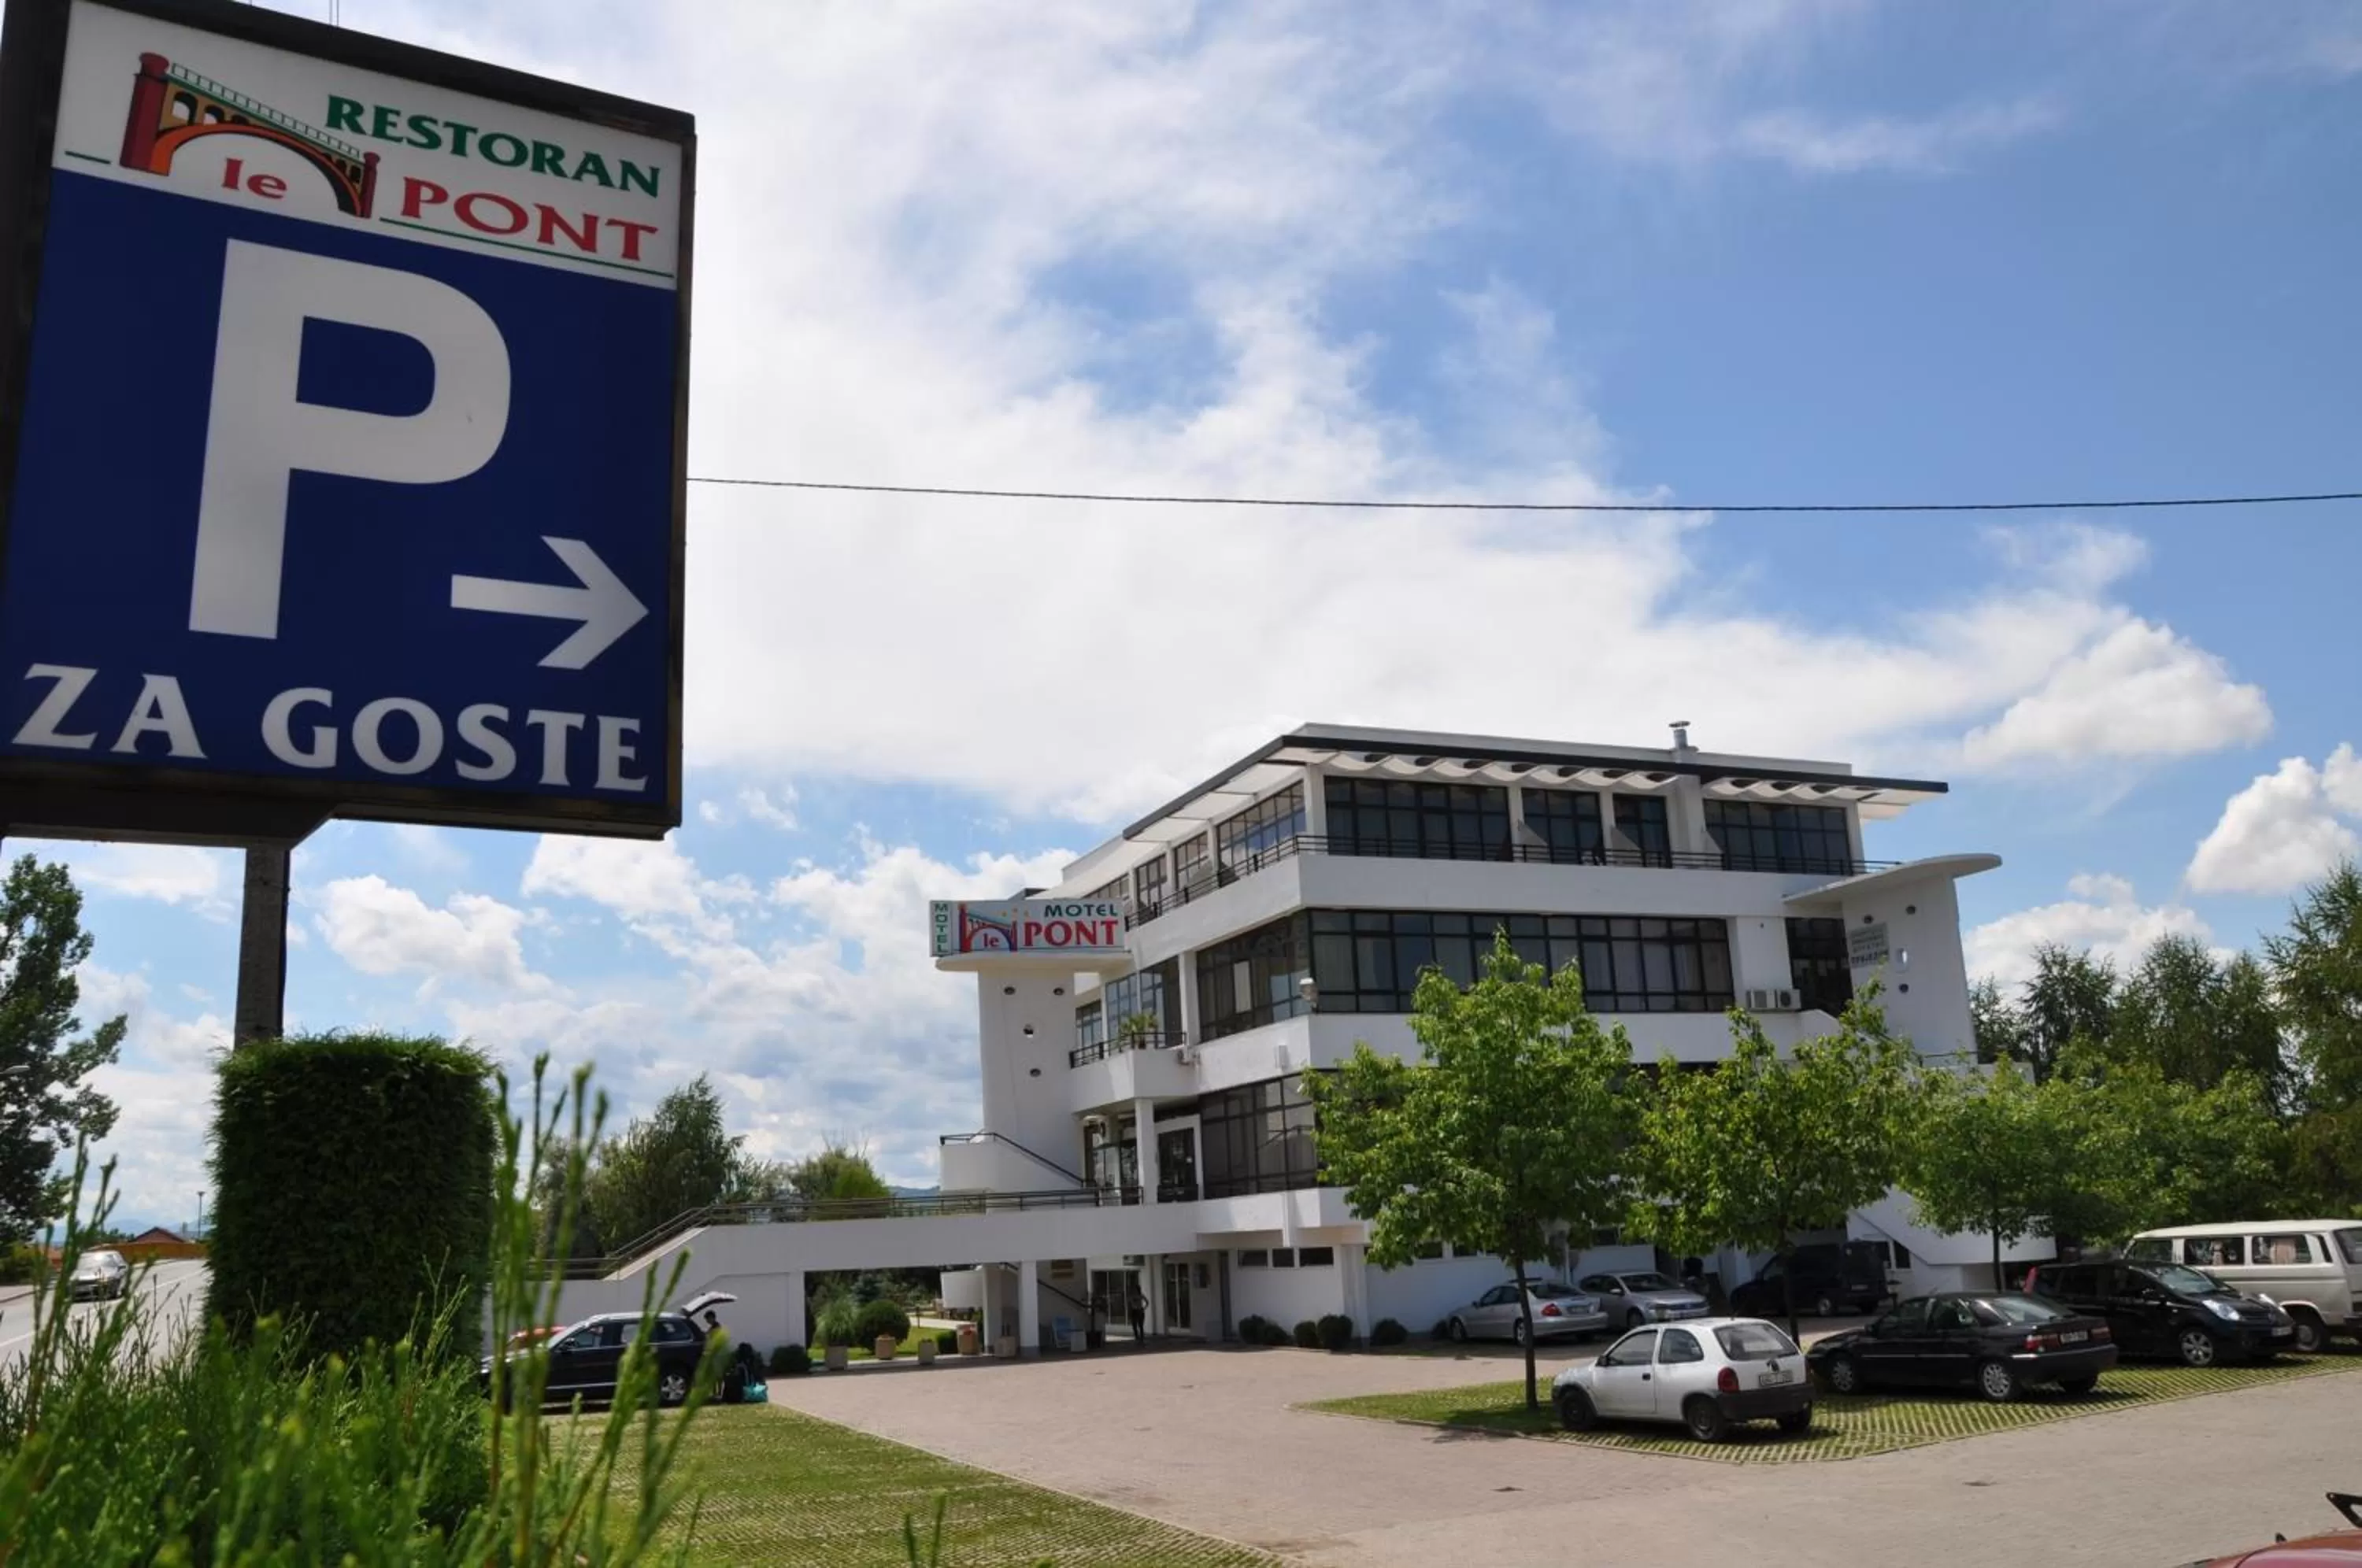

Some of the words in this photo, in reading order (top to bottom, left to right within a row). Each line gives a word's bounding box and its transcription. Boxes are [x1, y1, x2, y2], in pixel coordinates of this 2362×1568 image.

[326, 94, 661, 198] RESTORAN
[221, 158, 288, 200] le
[401, 176, 659, 261] PONT
[189, 239, 511, 639] P
[12, 663, 207, 759] ZA
[261, 686, 649, 792] GOSTE
[935, 903, 948, 952] MOTEL
[983, 933, 999, 947] le
[1024, 920, 1118, 946] PONT
[1045, 904, 1118, 917] MOTEL
